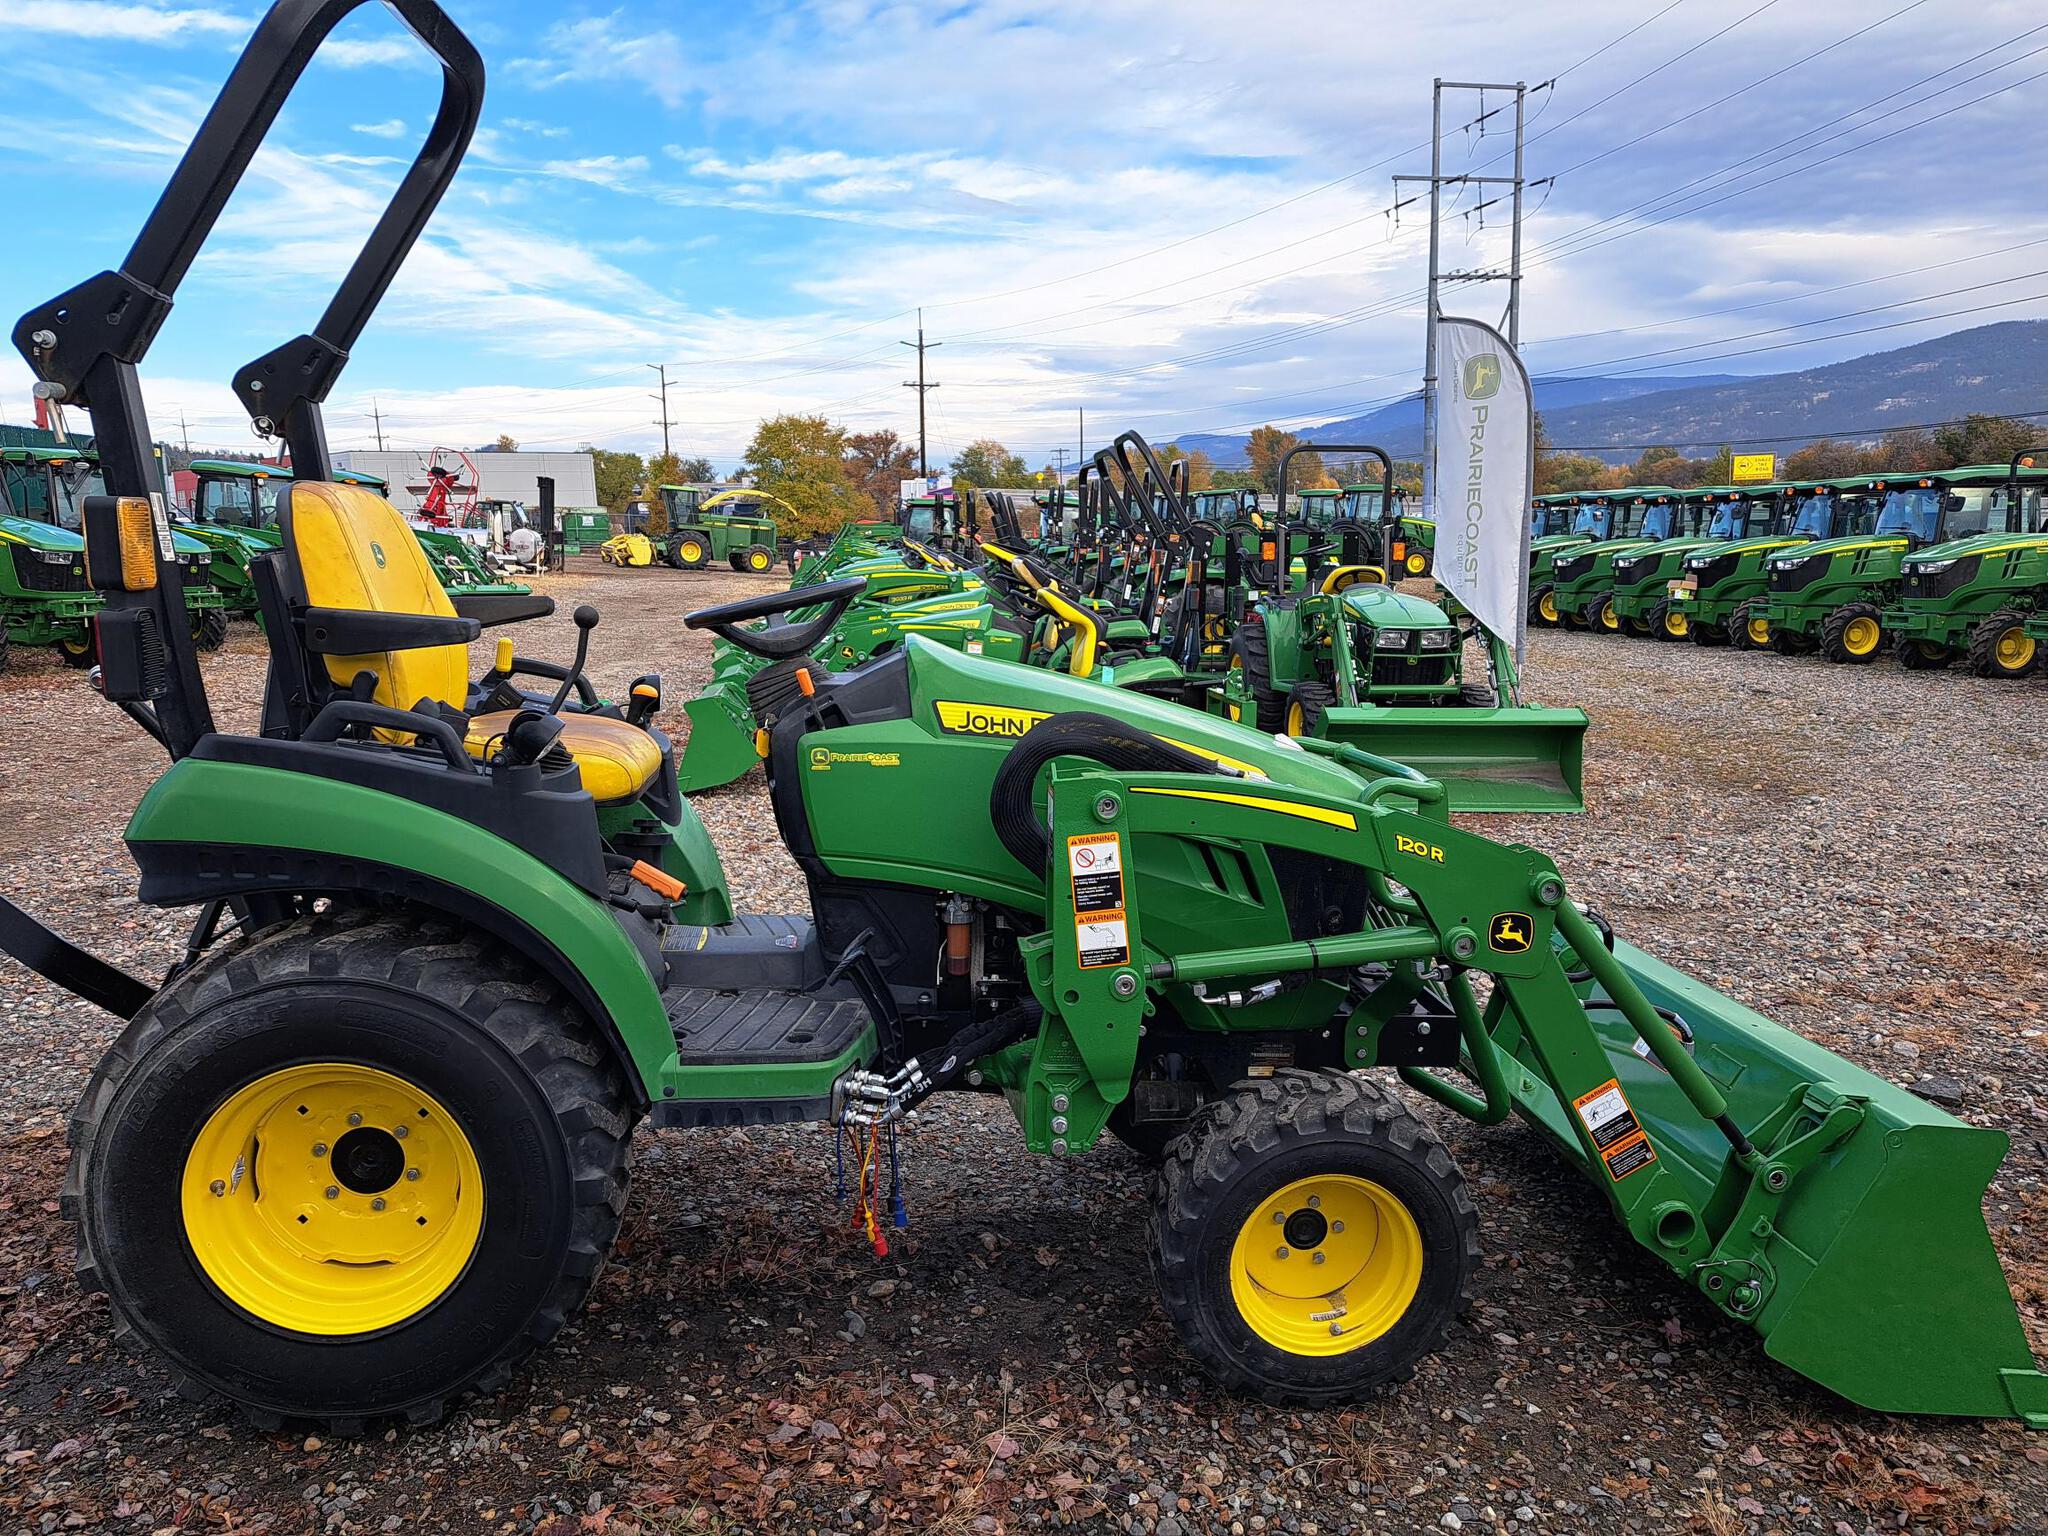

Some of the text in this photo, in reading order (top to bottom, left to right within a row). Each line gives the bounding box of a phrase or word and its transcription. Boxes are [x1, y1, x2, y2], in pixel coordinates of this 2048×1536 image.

[1464, 405, 1489, 589] PRAIRIECOAST
[957, 710, 1025, 734] JOHN
[1077, 834, 1116, 845] WARNING
[1395, 834, 1445, 863] 120 R
[1085, 912, 1124, 923] WARNING
[125, 1004, 290, 1133] CARLISLE
[1584, 1083, 1613, 1102] WARNING
[1613, 1135, 1642, 1153] WARNING
